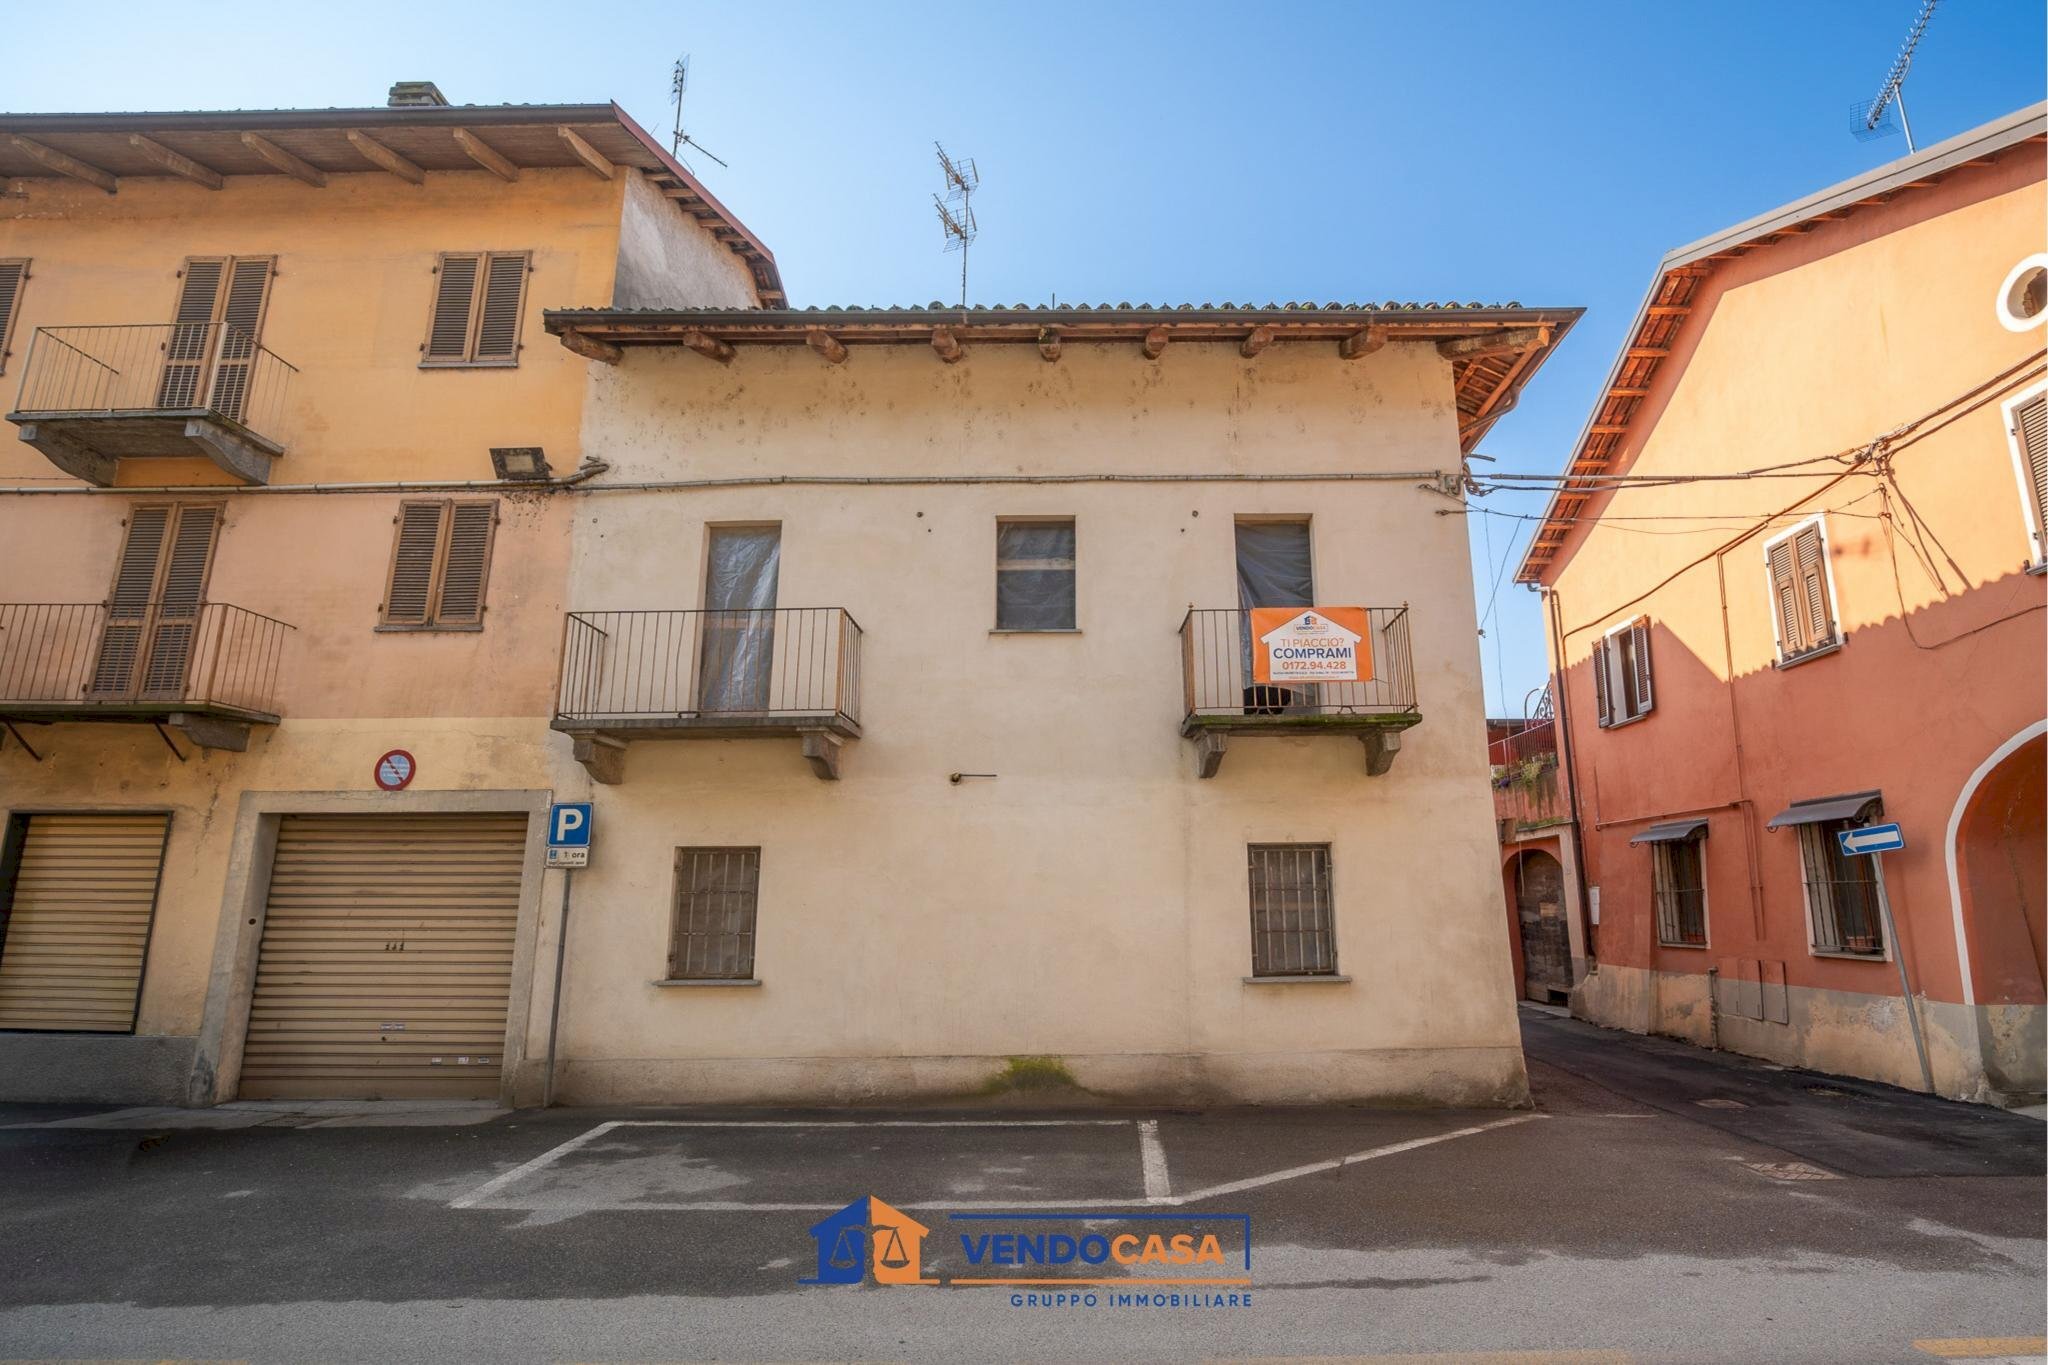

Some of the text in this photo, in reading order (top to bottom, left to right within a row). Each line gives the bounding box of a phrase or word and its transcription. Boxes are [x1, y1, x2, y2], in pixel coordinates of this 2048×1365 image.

[1282, 638, 1344, 647] TI PIACCIO?
[1273, 648, 1351, 658] COMPRAMI
[1282, 661, 1346, 670] 0172.94.428
[557, 809, 583, 841] P
